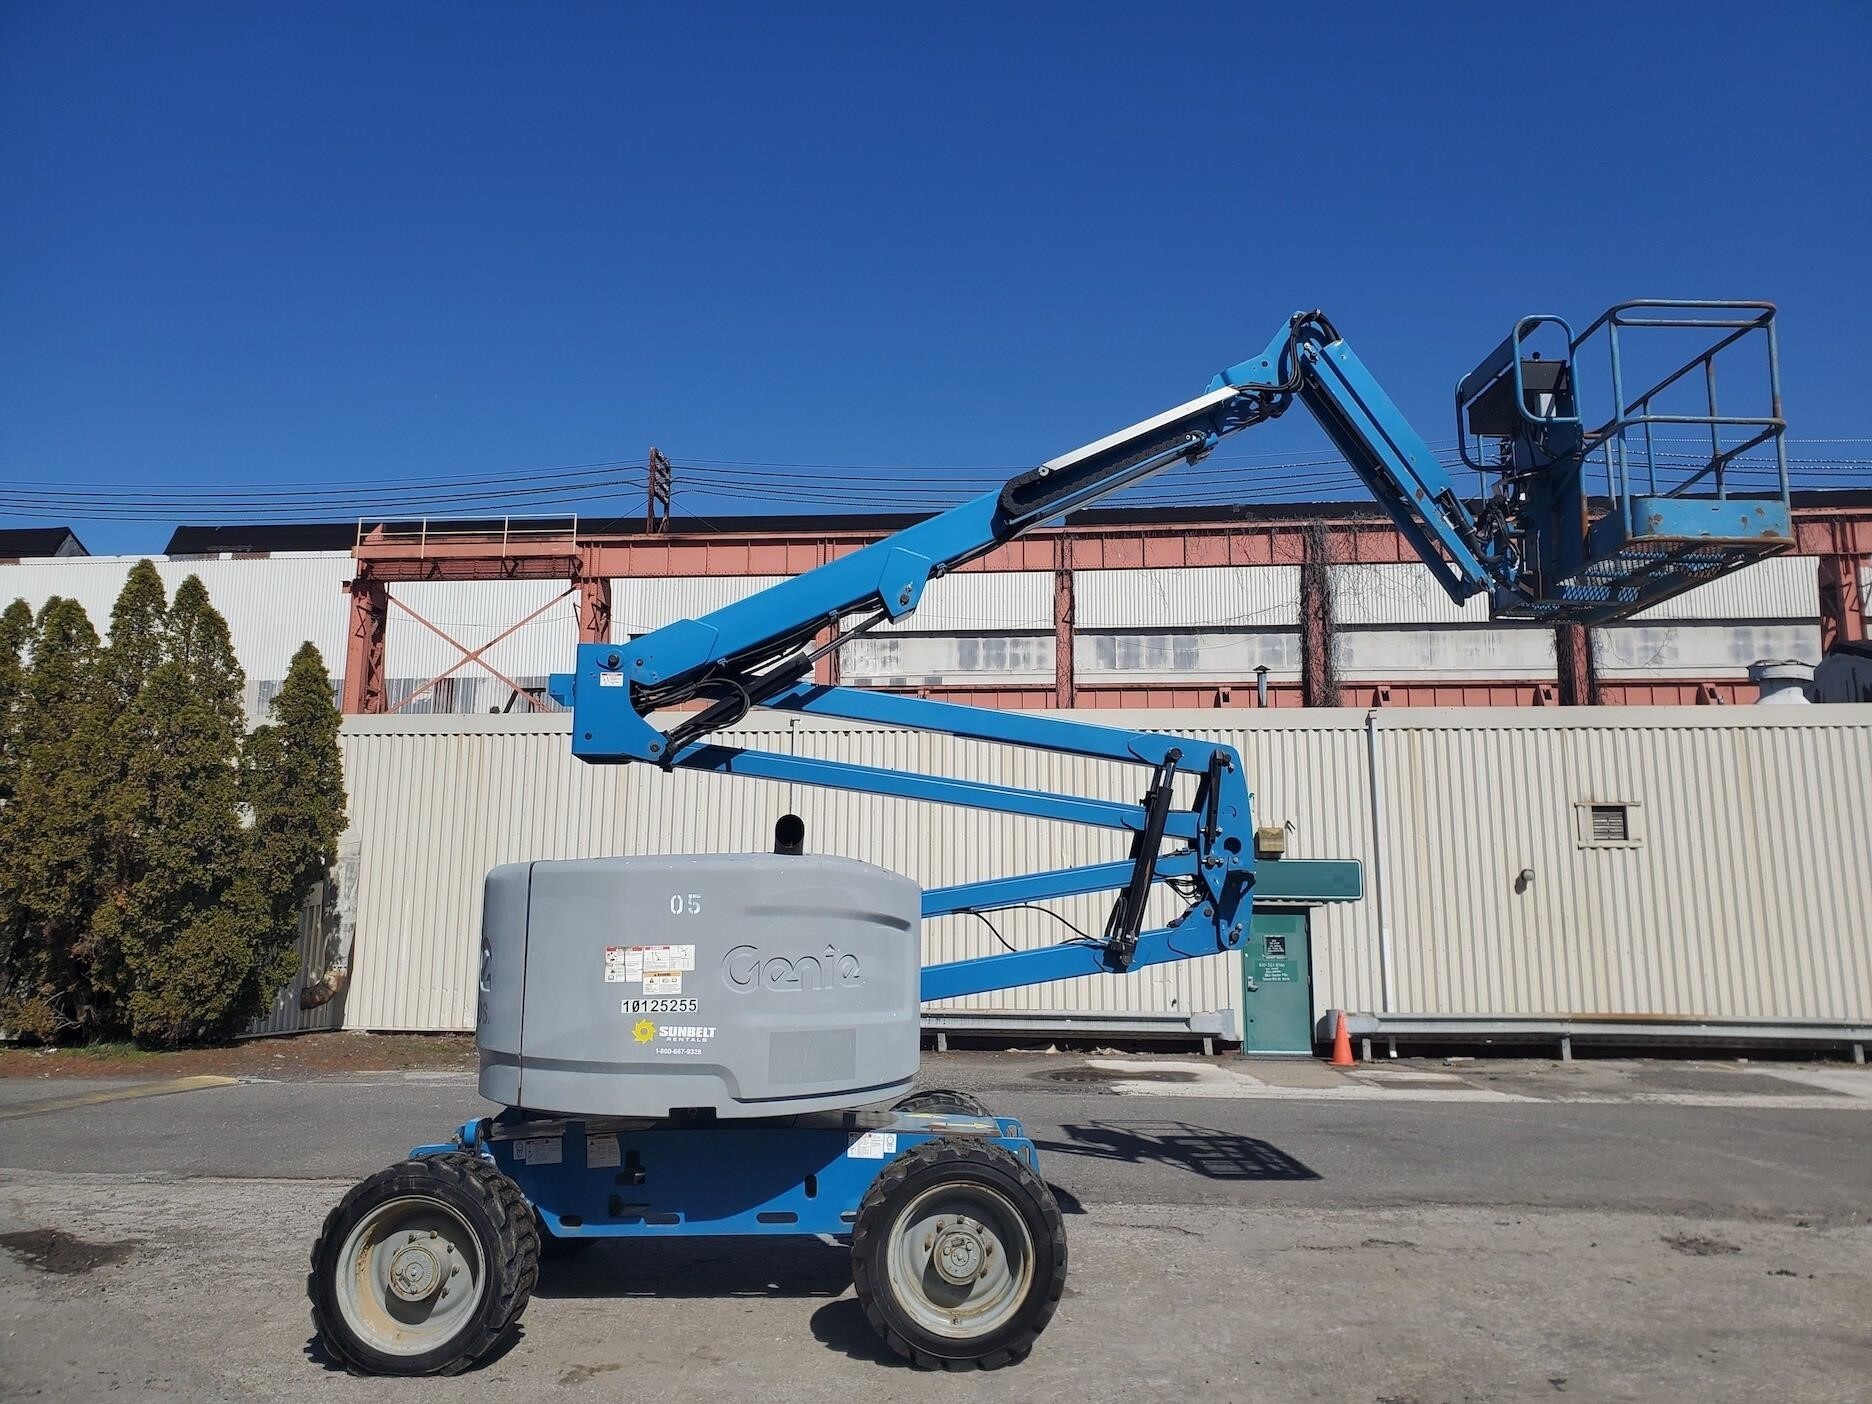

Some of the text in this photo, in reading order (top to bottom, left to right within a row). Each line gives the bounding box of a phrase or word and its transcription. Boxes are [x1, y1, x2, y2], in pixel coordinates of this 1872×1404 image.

[670, 893, 701, 915] 05
[721, 943, 861, 994] Genie
[623, 999, 697, 1013] 10125255
[659, 1026, 717, 1038] SUNBELT
